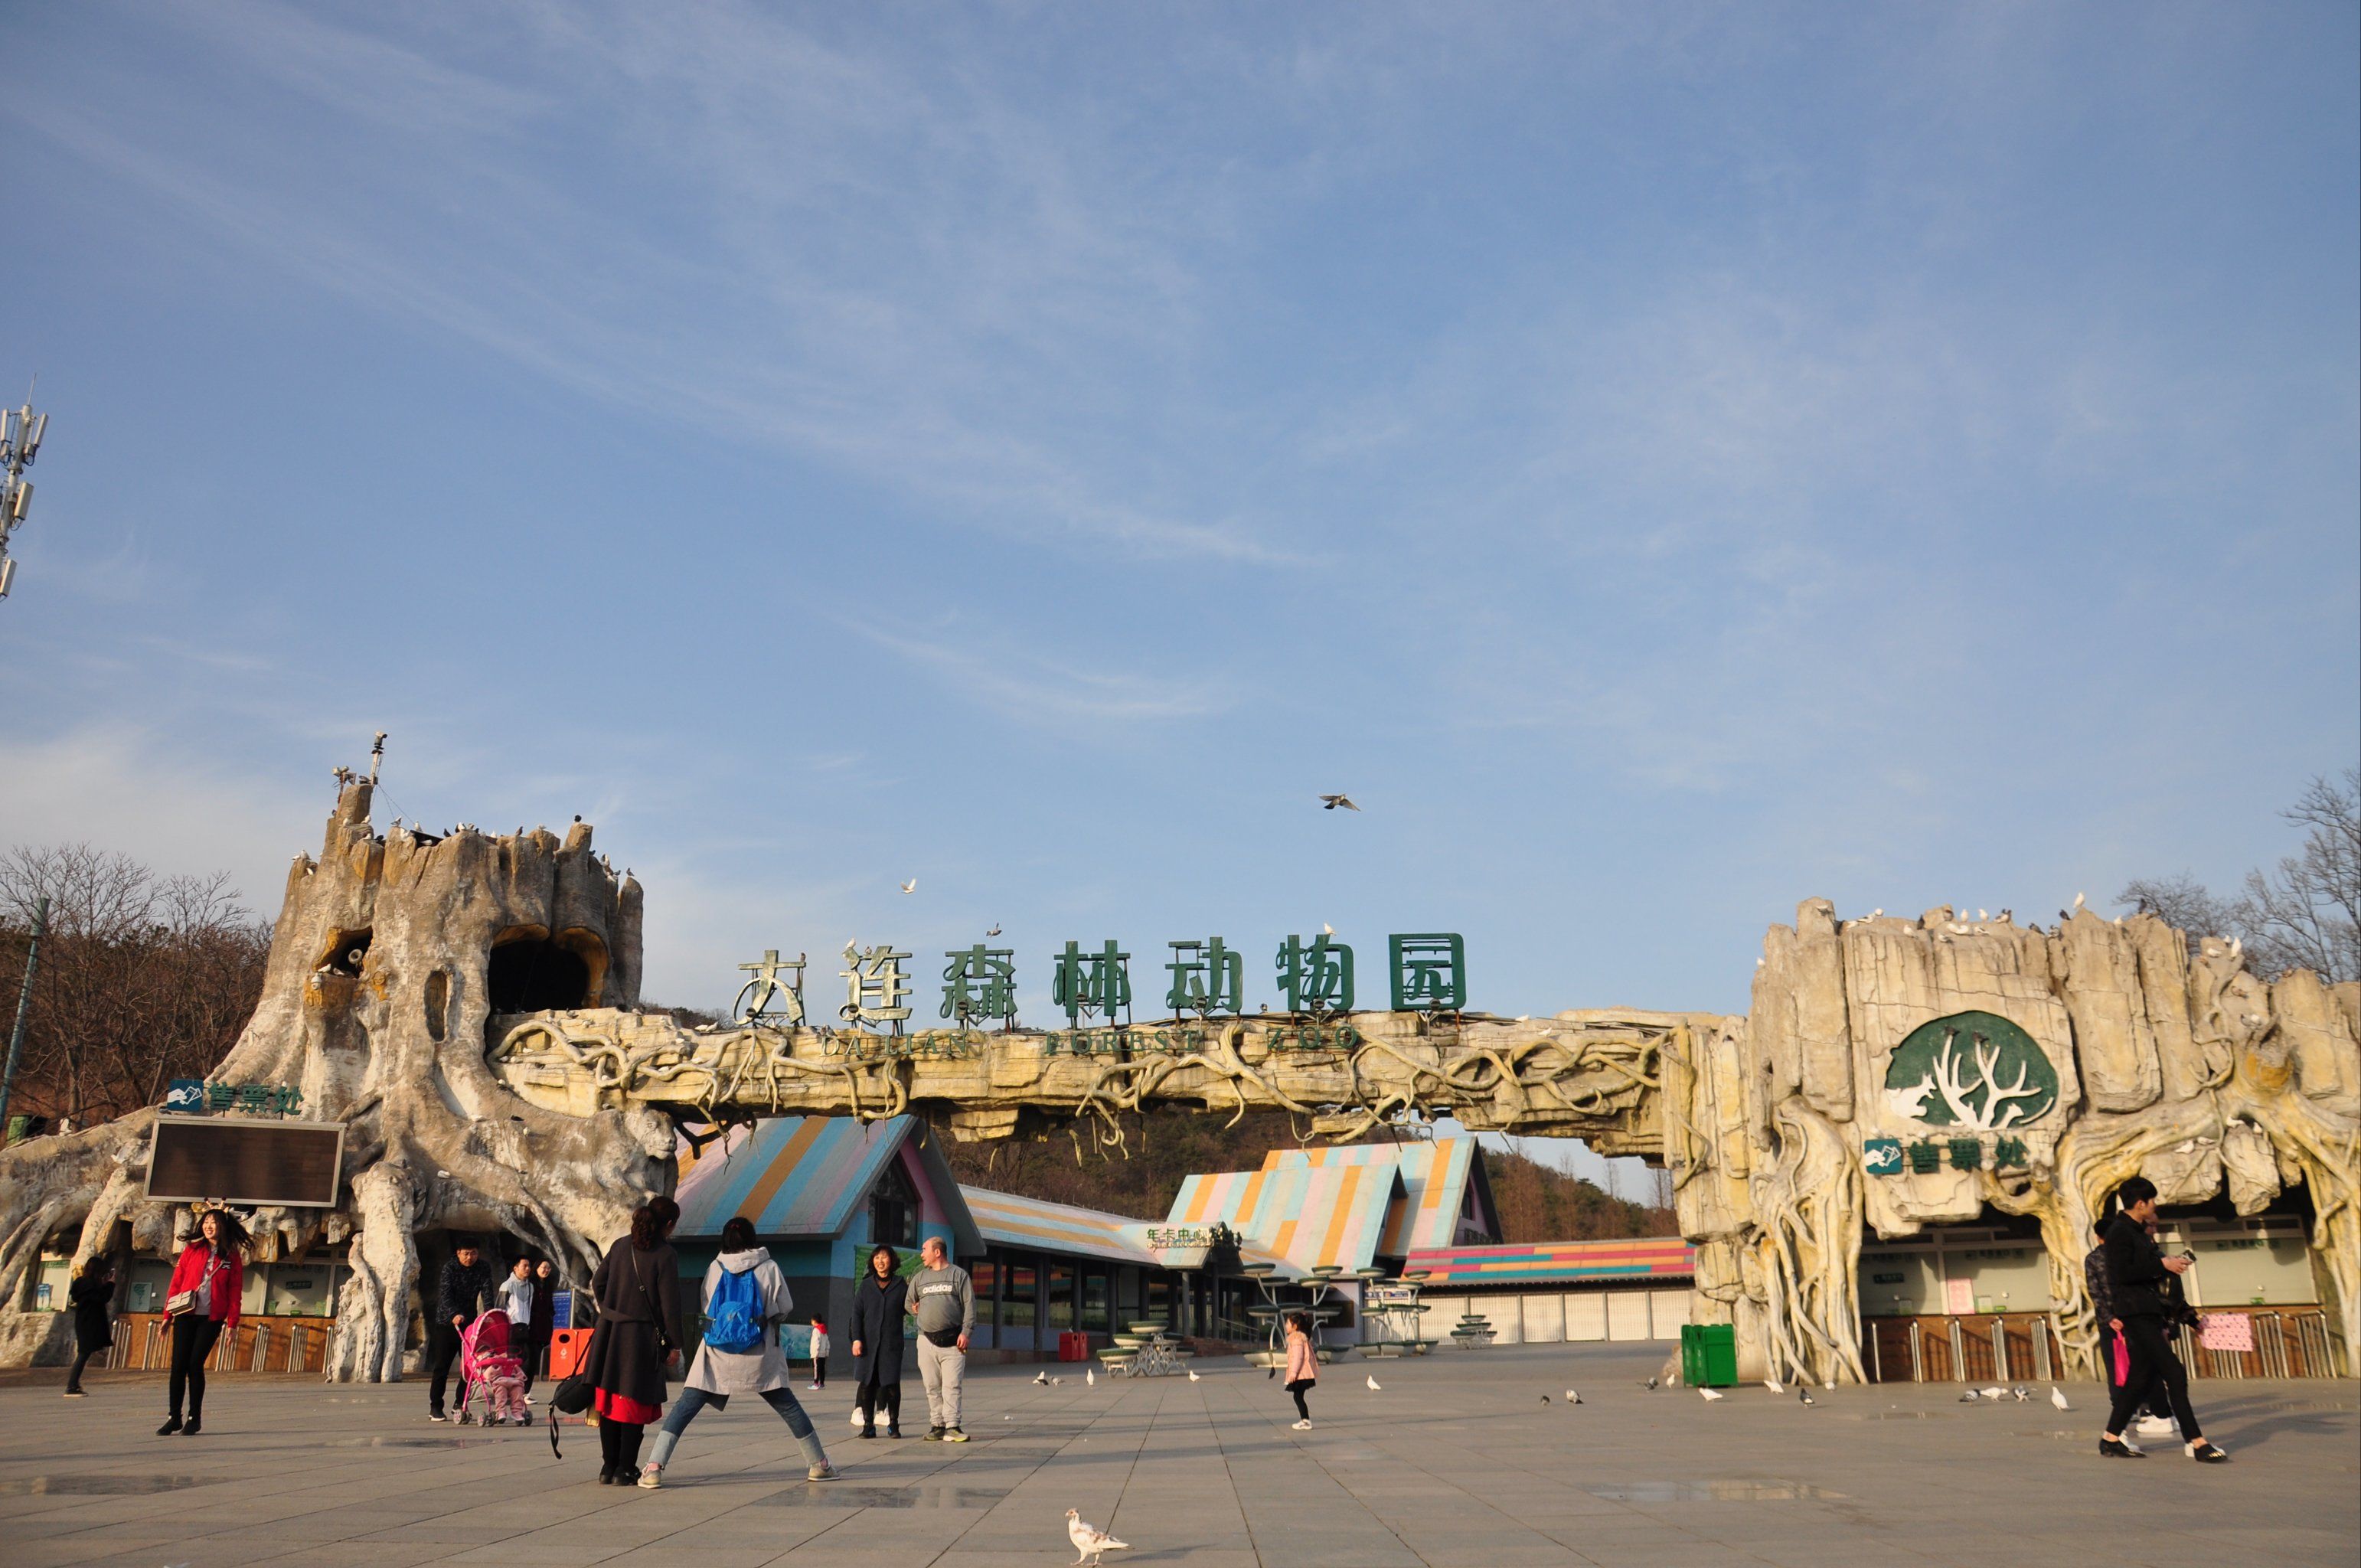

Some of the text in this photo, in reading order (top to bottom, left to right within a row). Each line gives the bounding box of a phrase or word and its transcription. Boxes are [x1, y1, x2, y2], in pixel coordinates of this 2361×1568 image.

[733, 933, 1467, 1025] 大连森林动物园
[819, 1026, 1358, 1057] DALIAN FOREST ZOO
[208, 1081, 304, 1115] 售票处
[1909, 1136, 2030, 1174] 售票处
[1147, 1228, 1207, 1241] 年卡中心
[922, 1284, 953, 1294] adidas
